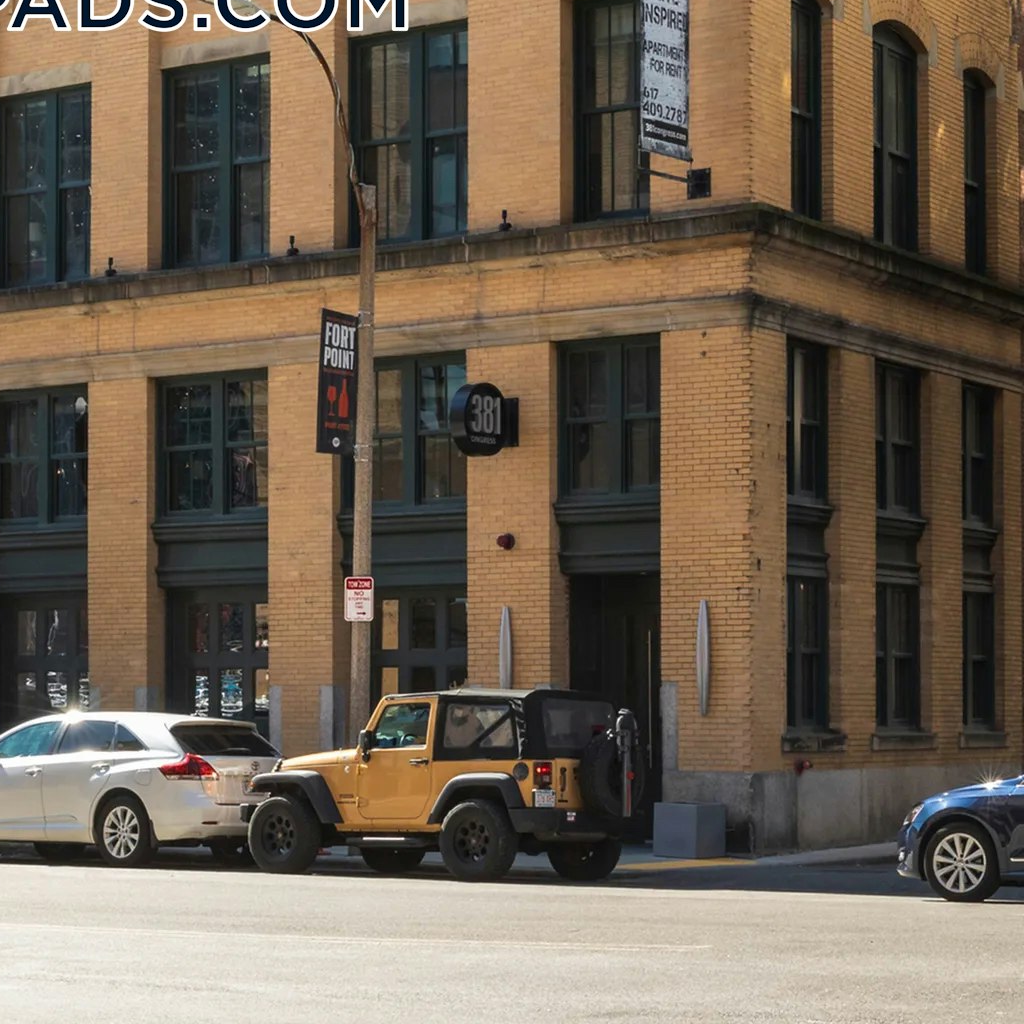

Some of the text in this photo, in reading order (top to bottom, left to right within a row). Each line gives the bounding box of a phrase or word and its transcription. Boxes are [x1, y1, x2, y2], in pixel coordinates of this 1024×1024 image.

[650, 57, 682, 79] FOR RENT
[643, 86, 659, 100] 617
[325, 321, 356, 350] FORT
[323, 345, 355, 371] POINT
[470, 394, 501, 435] 381
